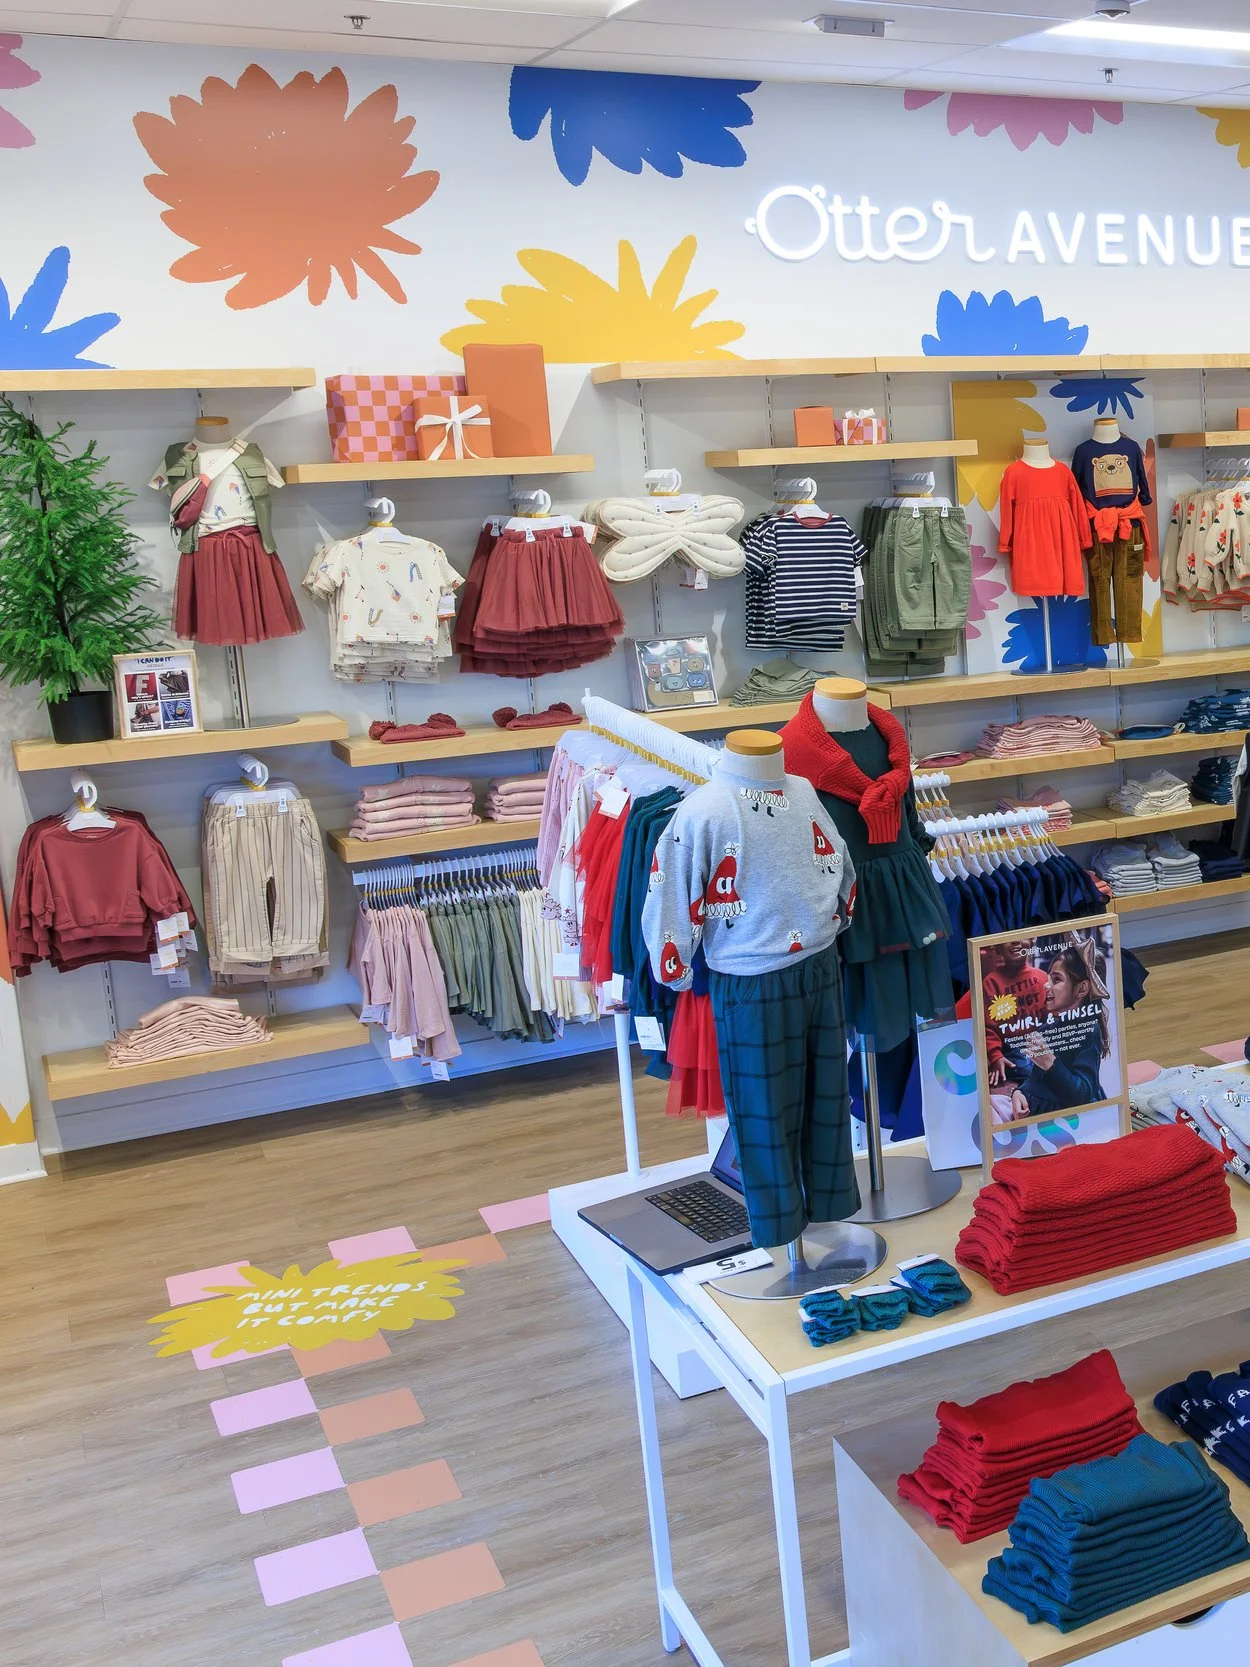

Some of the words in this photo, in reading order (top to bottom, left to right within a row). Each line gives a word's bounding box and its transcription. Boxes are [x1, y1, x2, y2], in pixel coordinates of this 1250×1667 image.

[745, 184, 997, 262] Otter
[1044, 941, 1073, 953] AVENUE
[999, 1016, 1042, 1034] TWIRL
[1046, 1013, 1055, 1025] &
[1058, 1003, 1102, 1022] TINSEL
[1004, 1035, 1024, 1043] Festive
[1078, 1019, 1099, 1029] anyone?
[1062, 1027, 1095, 1038] RSVP-worthy
[1069, 1035, 1086, 1043] check!
[237, 1287, 303, 1301] MINI
[311, 1281, 428, 1297] TRENDS
[242, 1301, 310, 1315] BUT
[314, 1295, 400, 1310] MAKE
[235, 1317, 272, 1329] IT
[277, 1309, 382, 1327] COMFY
